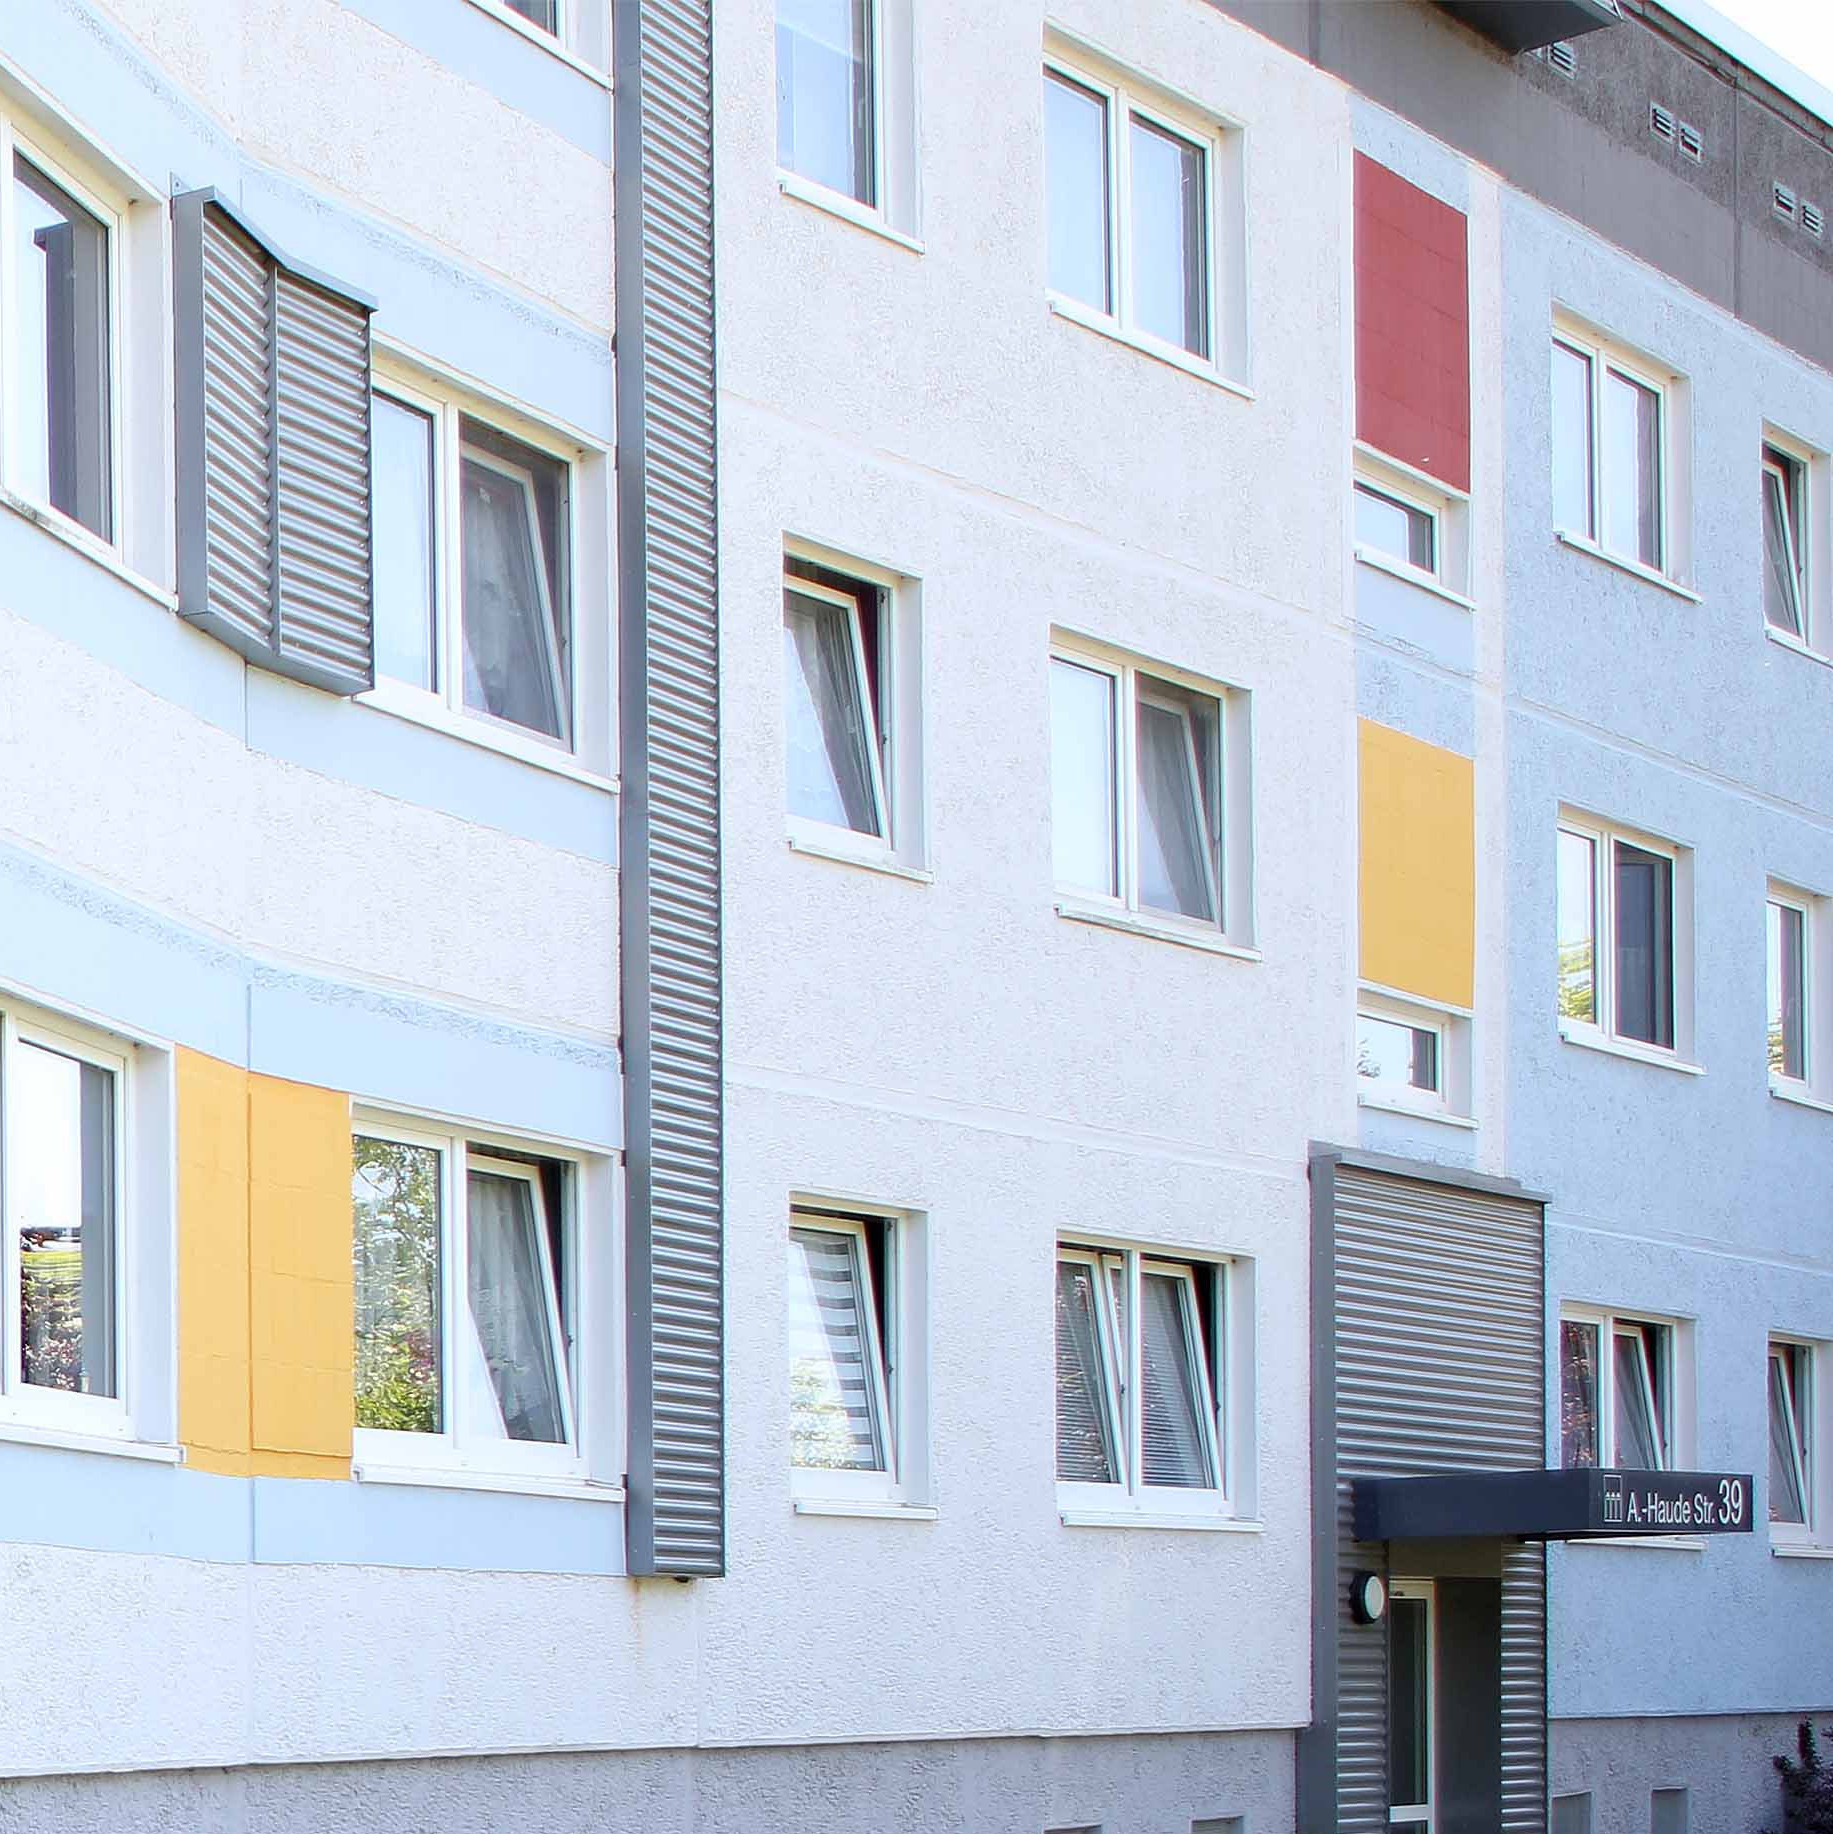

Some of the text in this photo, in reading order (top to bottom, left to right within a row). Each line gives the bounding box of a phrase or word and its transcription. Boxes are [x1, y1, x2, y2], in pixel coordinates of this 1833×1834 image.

[1627, 1480, 1742, 1524] A.-Haude Str. 39
